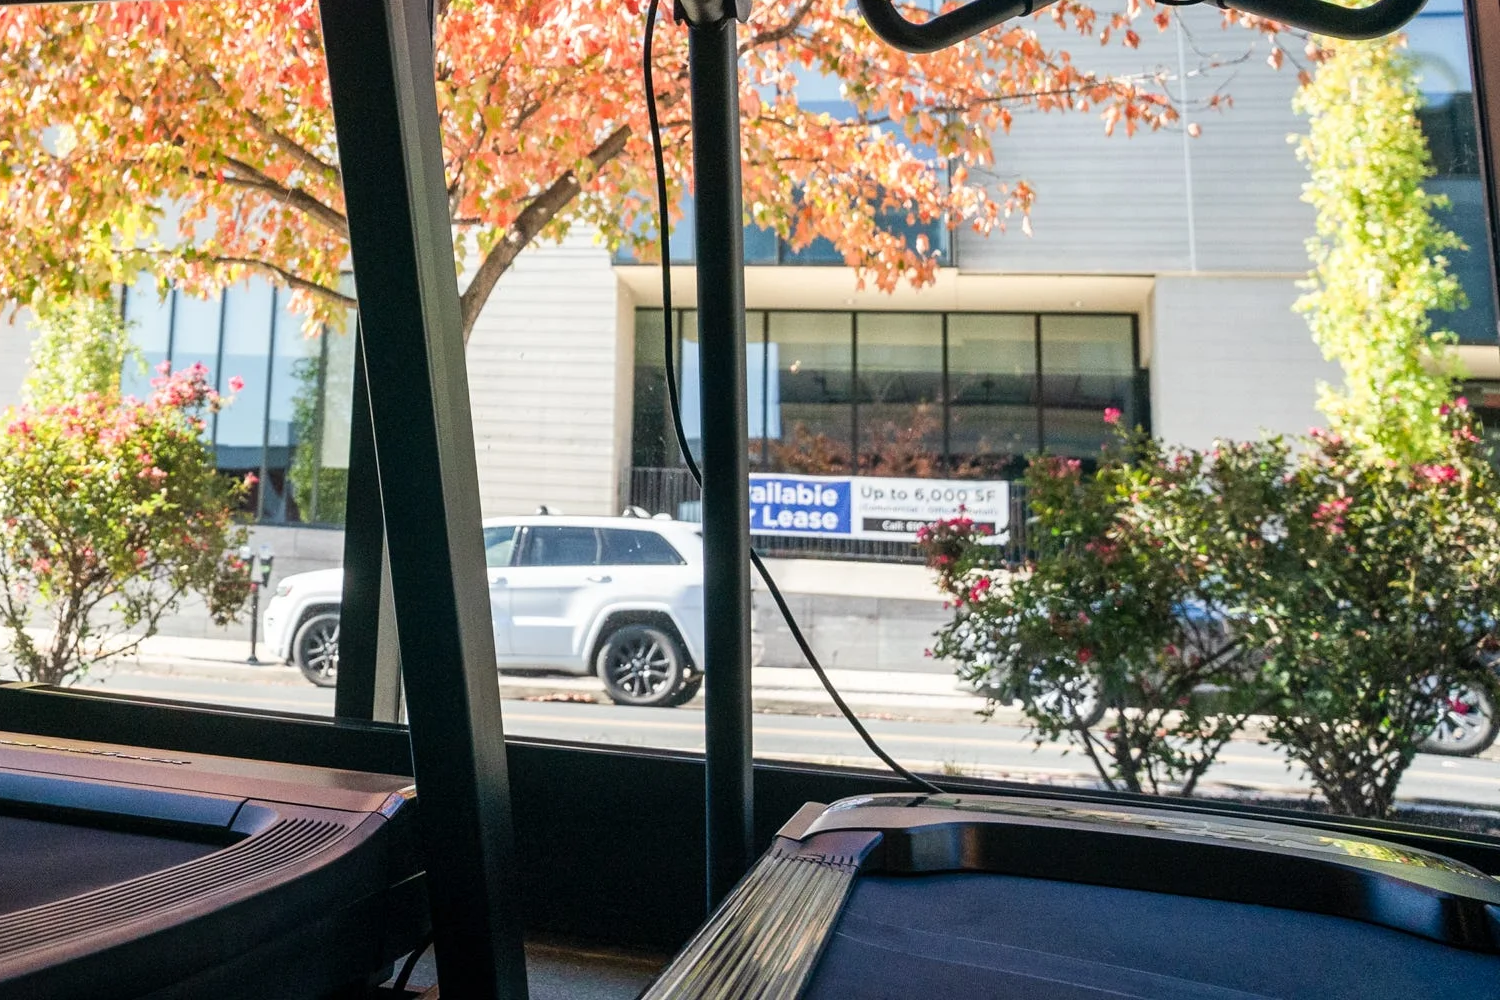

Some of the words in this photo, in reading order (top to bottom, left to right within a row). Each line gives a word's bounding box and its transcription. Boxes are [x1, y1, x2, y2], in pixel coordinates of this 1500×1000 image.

[750, 481, 839, 507] ailable
[860, 486, 884, 501] Up
[891, 489, 908, 501] to
[914, 488, 968, 503] 6,000
[975, 489, 996, 502] SF
[762, 504, 839, 530] Lease
